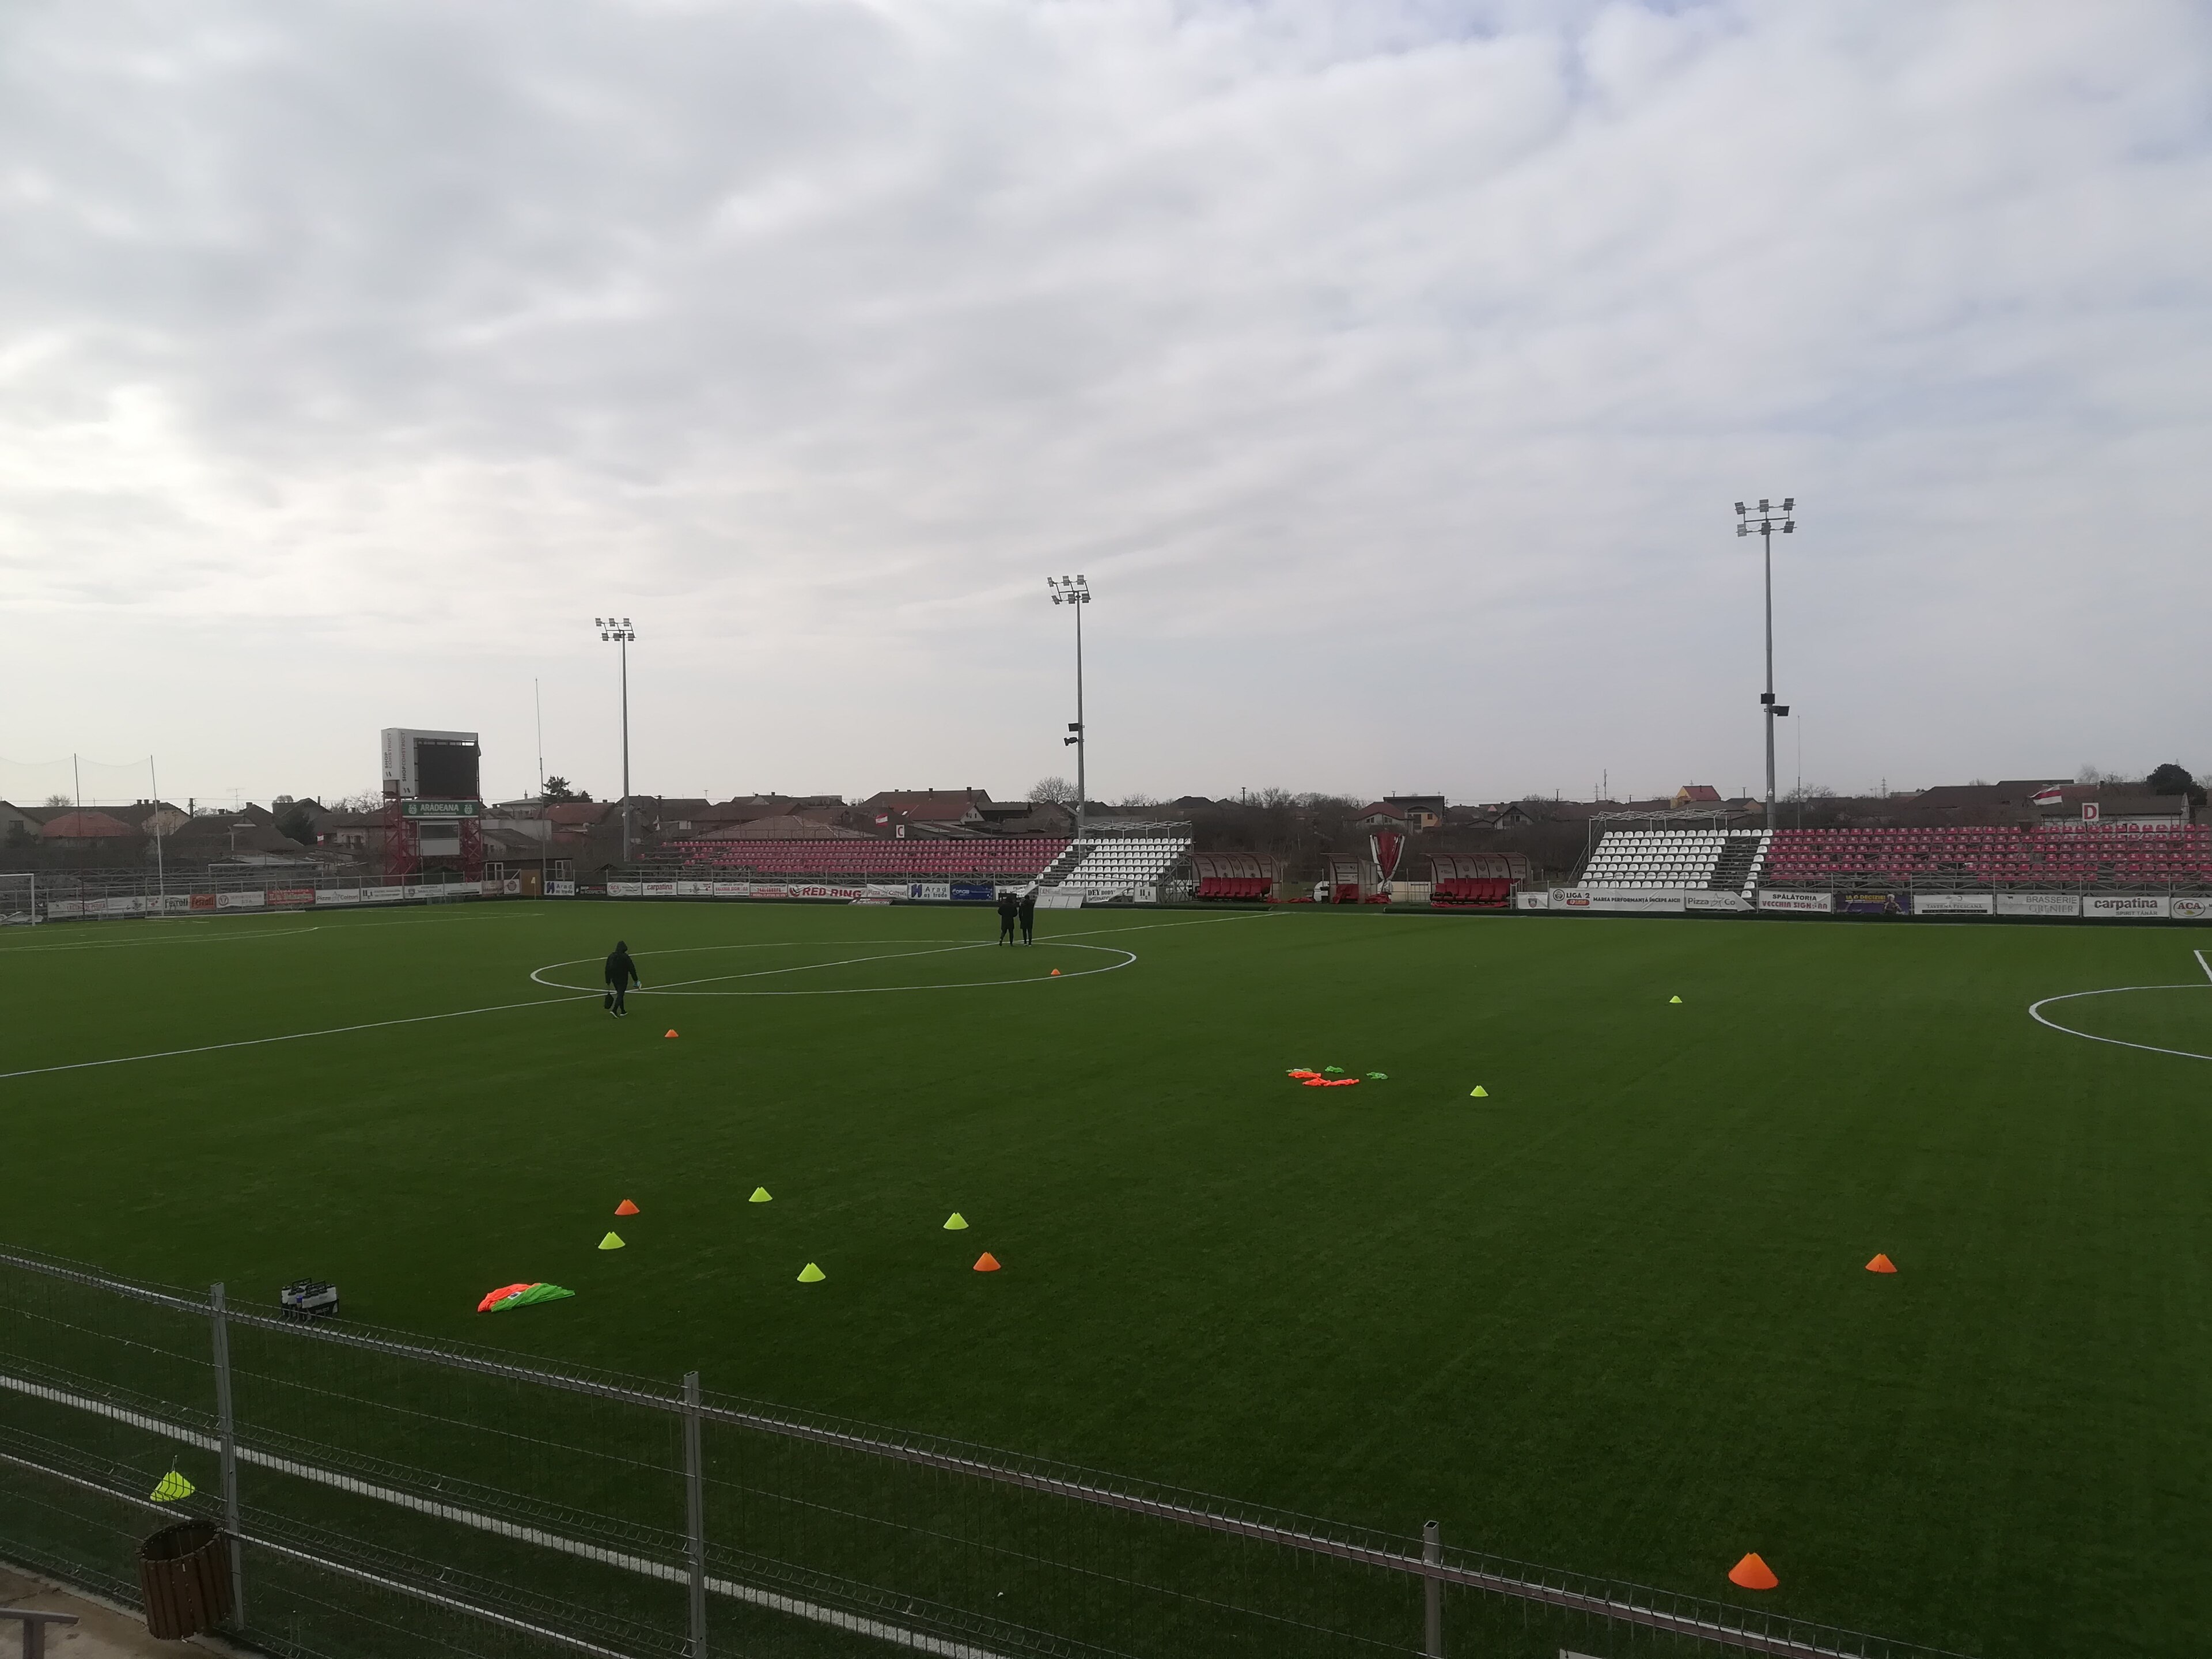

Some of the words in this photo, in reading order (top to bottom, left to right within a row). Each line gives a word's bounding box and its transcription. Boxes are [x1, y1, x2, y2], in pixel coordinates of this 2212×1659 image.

[421, 803, 459, 811] ARĂDEANA
[2084, 805, 2097, 819] D
[897, 826, 903, 836] C
[802, 888, 827, 896] RED
[830, 889, 862, 898] RING
[165, 898, 189, 908] Ferroli
[2094, 898, 2158, 910] carpatina
